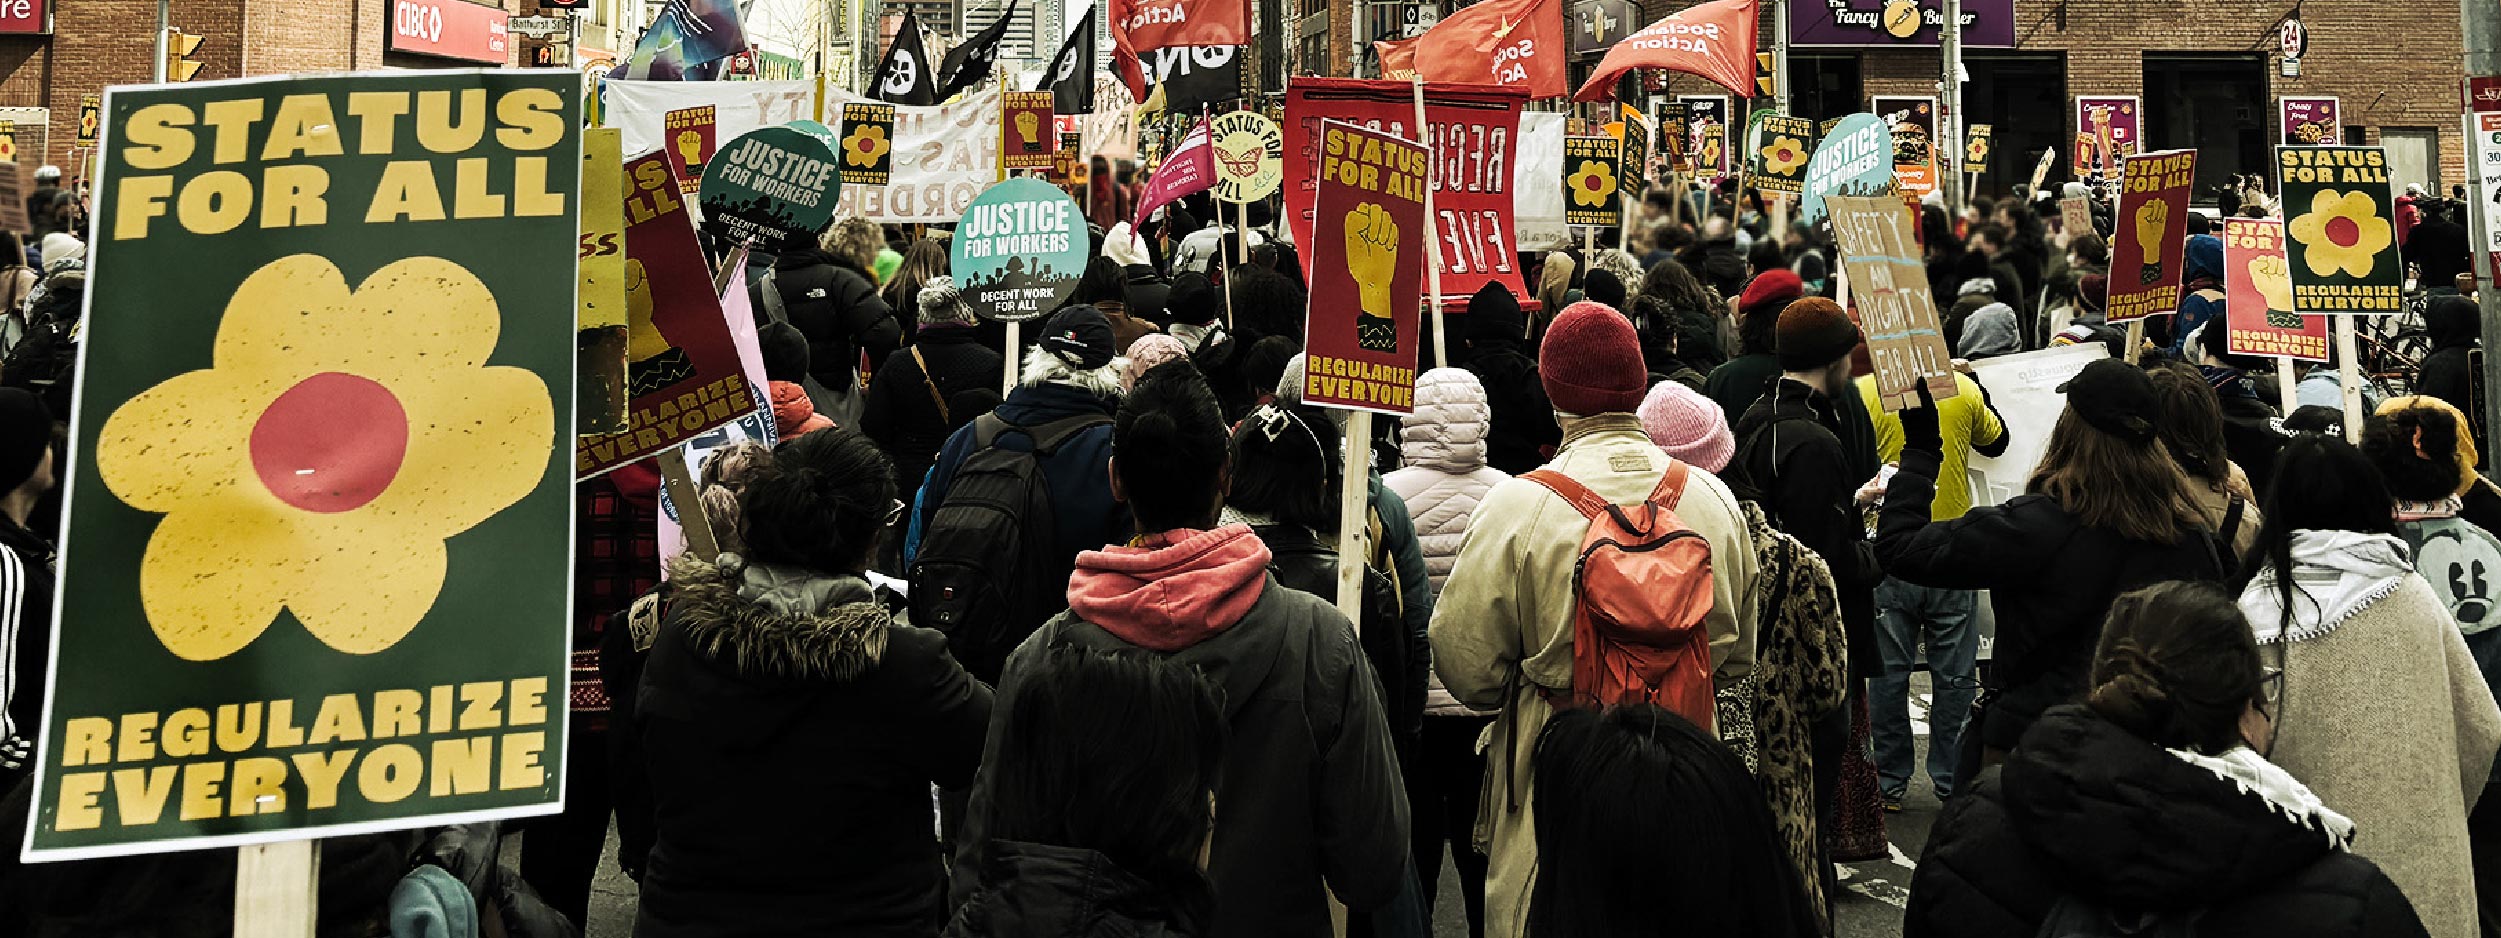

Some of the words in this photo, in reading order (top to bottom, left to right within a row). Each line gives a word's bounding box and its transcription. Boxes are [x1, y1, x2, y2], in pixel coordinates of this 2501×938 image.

[397, 1, 429, 39] CIBC
[1836, 9, 1879, 29] Fancy
[1924, 8, 1976, 25] Buer
[2284, 24, 2298, 45] 24
[666, 106, 714, 121] STATUS
[844, 112, 867, 121] FOR
[871, 113, 894, 122] ALL
[846, 103, 894, 115] STATUS
[123, 88, 566, 170] STATUS
[667, 120, 686, 130] FOR
[692, 113, 715, 126] ALL
[1211, 114, 1264, 143] STATUS
[1260, 130, 1284, 160] FOR
[1566, 139, 1617, 150] STATUS
[1326, 128, 1426, 177] STATUS
[1566, 149, 1593, 158] FOR
[1595, 149, 1617, 158] ALL
[1811, 122, 1881, 182] JUSTICE
[2281, 150, 2384, 167] STATUS
[729, 138, 836, 192] JUSTICE
[1811, 176, 1829, 198] FOR
[1830, 150, 1880, 188] WORKERS
[2125, 153, 2192, 177] STATUS
[2283, 167, 2334, 183] FOR
[2342, 167, 2387, 183] ALL
[719, 164, 752, 187] FOR
[752, 174, 821, 208] WORKERS
[1217, 177, 1243, 201] ALL
[1323, 156, 1379, 191] FOR
[1386, 171, 1424, 204] ALL
[2123, 176, 2160, 194] FOR
[2164, 171, 2190, 190] ALL
[114, 165, 331, 242] FOR
[365, 156, 566, 223] ALL
[718, 212, 758, 232] DECENT
[757, 225, 788, 241] WORK
[965, 200, 1069, 239] JUSTICE
[2227, 222, 2285, 237] STAT
[727, 226, 750, 239] FOR
[1836, 208, 1906, 260] SAFETY
[2227, 235, 2274, 250] FOR
[964, 238, 992, 260] FOR
[995, 233, 1069, 256] WORKERS
[980, 289, 1020, 302] DECENT
[1023, 287, 1055, 299] WORK
[2110, 285, 2177, 305] REGULARIZE
[2296, 284, 2400, 296] REGULARIZE
[995, 302, 1016, 312] FOR
[1018, 299, 1038, 311] ALL
[1860, 287, 1935, 334] DIGNITY
[2107, 296, 2176, 319] EVERYONE
[2297, 296, 2400, 309] EVERYONE
[2232, 329, 2325, 347] REGULARIZE
[2232, 339, 2325, 358] EVERYONE
[1309, 354, 1413, 387] REGULARIZE
[1875, 347, 1912, 392] FOR
[1908, 345, 1947, 386] ALL
[1308, 375, 1413, 407] EVERYONE
[577, 391, 749, 472] EVERYONE
[62, 676, 548, 768] REGULARIZE
[55, 731, 546, 832] EVERYONE
